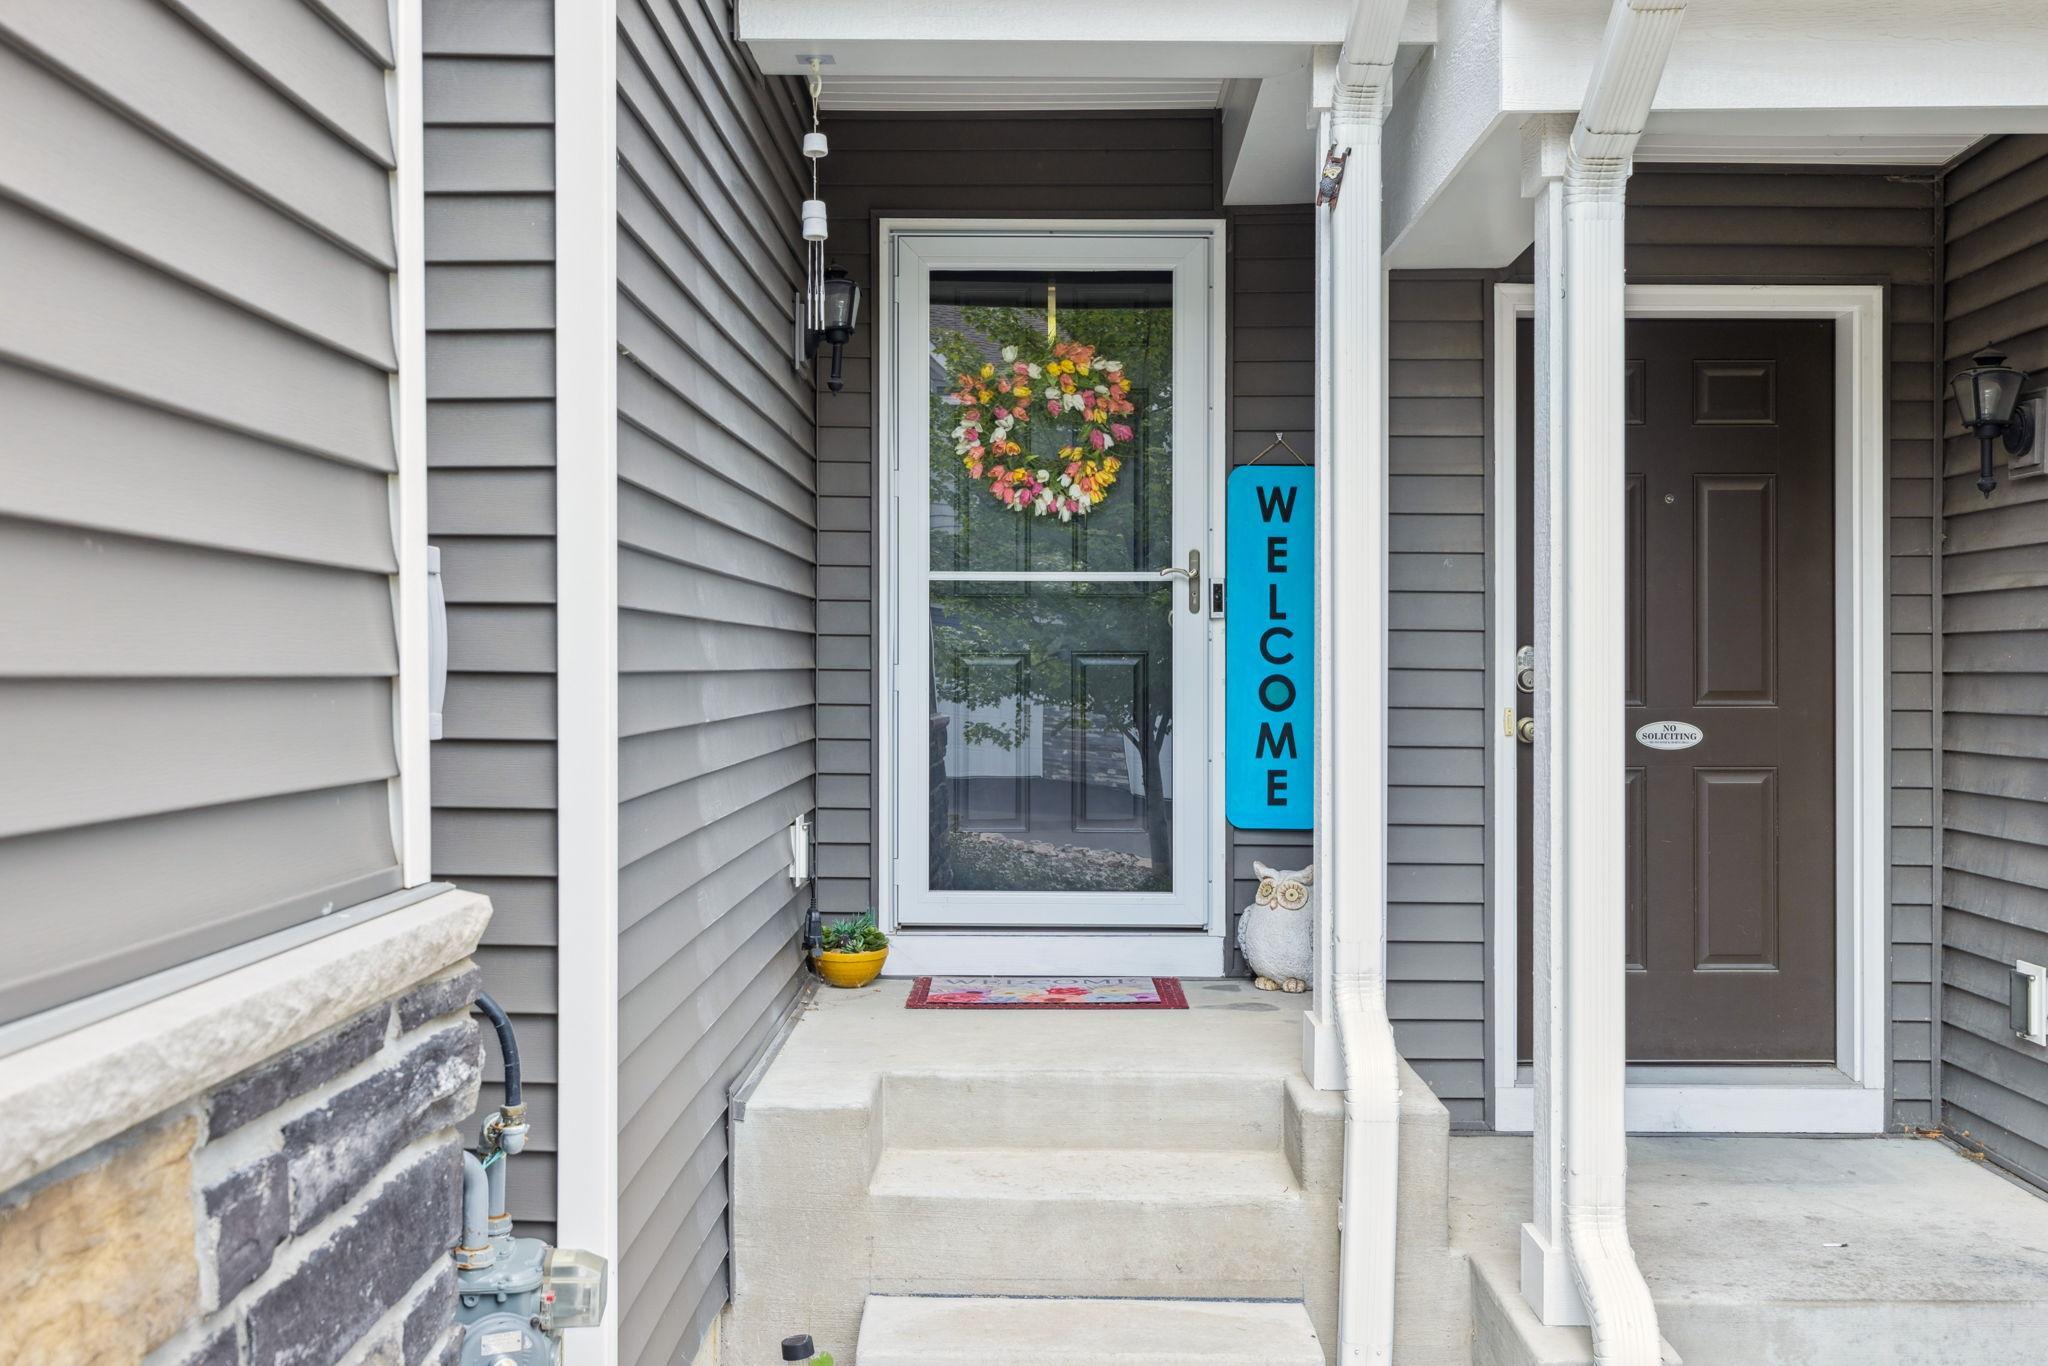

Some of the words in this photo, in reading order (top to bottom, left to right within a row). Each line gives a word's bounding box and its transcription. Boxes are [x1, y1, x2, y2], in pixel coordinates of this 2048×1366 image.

[1255, 486, 1298, 806] WELCOME
[1663, 724, 1677, 732] NO
[945, 978, 1137, 986] WELCOME
